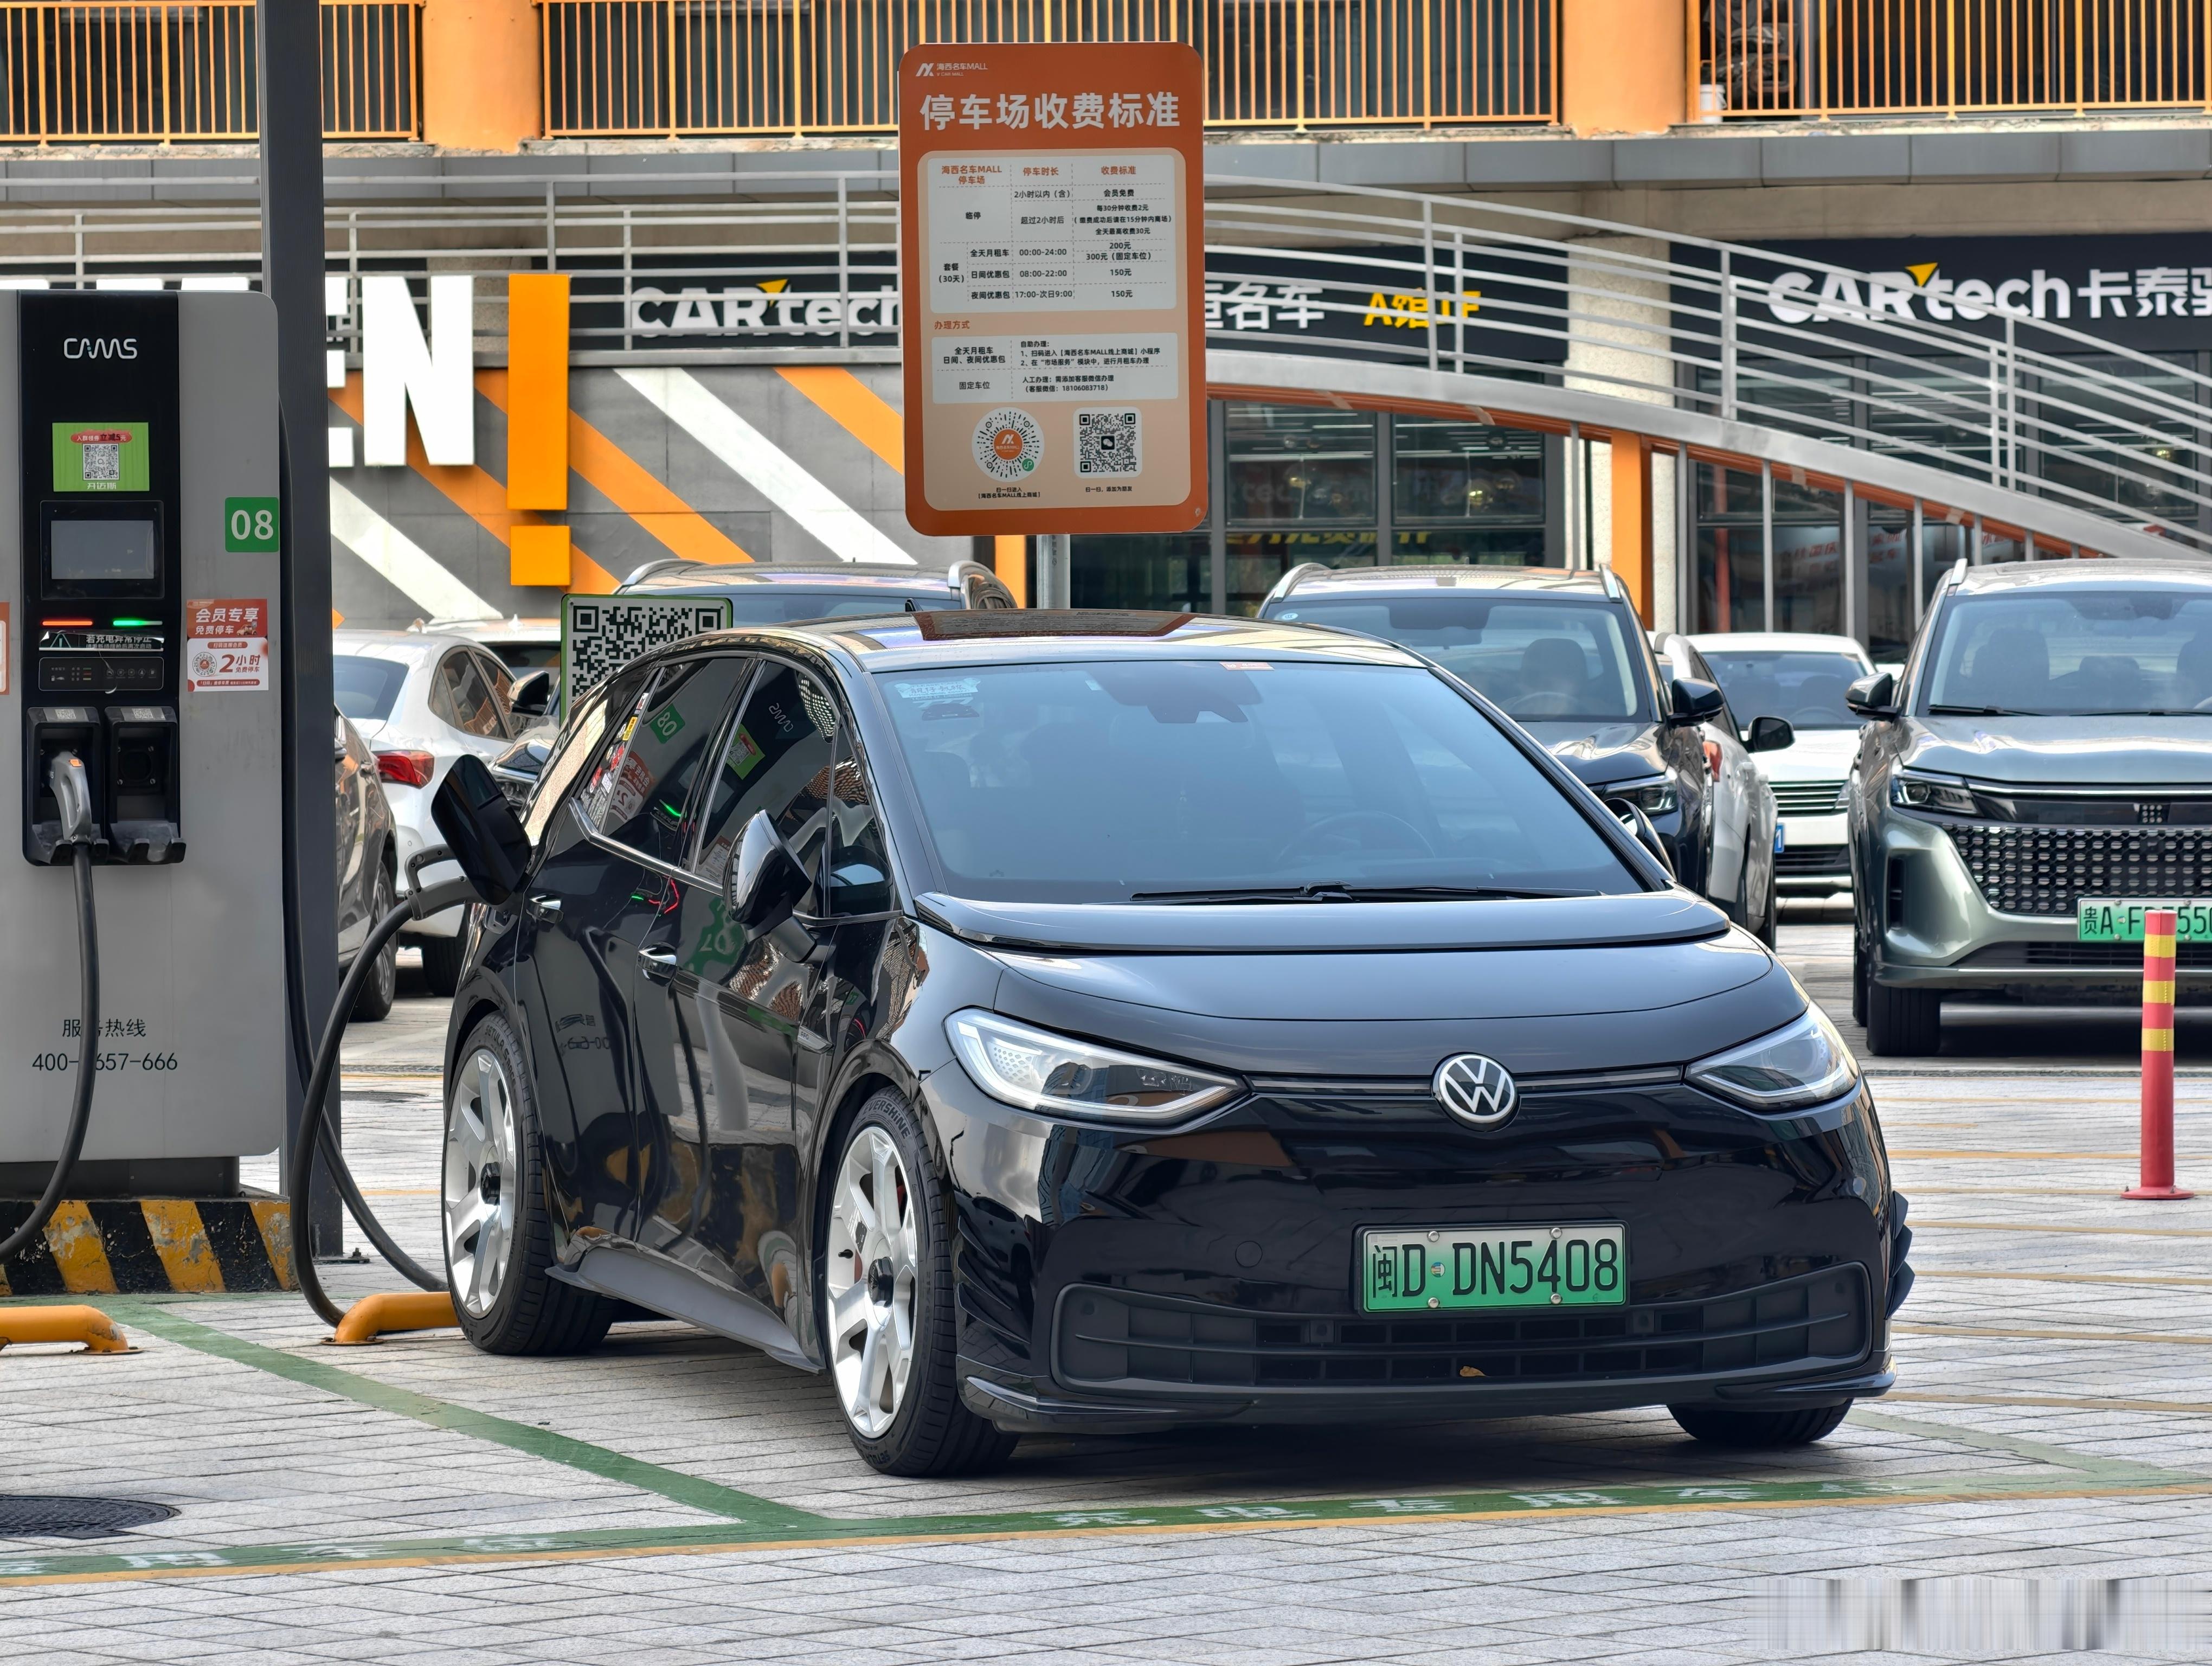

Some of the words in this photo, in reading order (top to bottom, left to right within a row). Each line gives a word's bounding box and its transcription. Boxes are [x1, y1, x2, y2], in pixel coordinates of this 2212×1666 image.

[936, 62, 988, 71] 海西名车MALL
[919, 92, 1180, 131] 停车场收费标准
[941, 165, 1002, 175] 海西名车MALL
[1023, 167, 1059, 176] 停车时长
[1101, 165, 1137, 175] 收费标准
[958, 175, 985, 184] 停车场
[1103, 189, 1135, 197] 会员免费
[1097, 204, 1149, 212] 每30分钟收费2元
[965, 212, 981, 220] 临停
[1020, 216, 1065, 225] 超过2小时后
[1095, 227, 1151, 235] 全天最高收费30元
[970, 249, 1009, 257] 全天月租车
[943, 263, 959, 271] 套餐
[971, 270, 1010, 279] 日间优惠包
[1110, 268, 1132, 276] 150元
[971, 291, 1010, 300] 夜间优惠包
[1015, 290, 1073, 298] 17:00-次日9:00
[1111, 290, 1133, 298] 150元
[1767, 269, 2070, 324] CARtech
[934, 320, 970, 330] 办理方式
[954, 347, 994, 355] 全天月租车
[943, 355, 1006, 364] 日间、夜间优惠包
[959, 381, 991, 390] 固定车位
[87, 482, 117, 490] 开迈斯
[231, 509, 274, 540] 08
[195, 607, 259, 623] 会员专享
[195, 625, 234, 635] 免费停车
[62, 1018, 146, 1038] 服热线
[32, 1052, 178, 1071] 400-657-666
